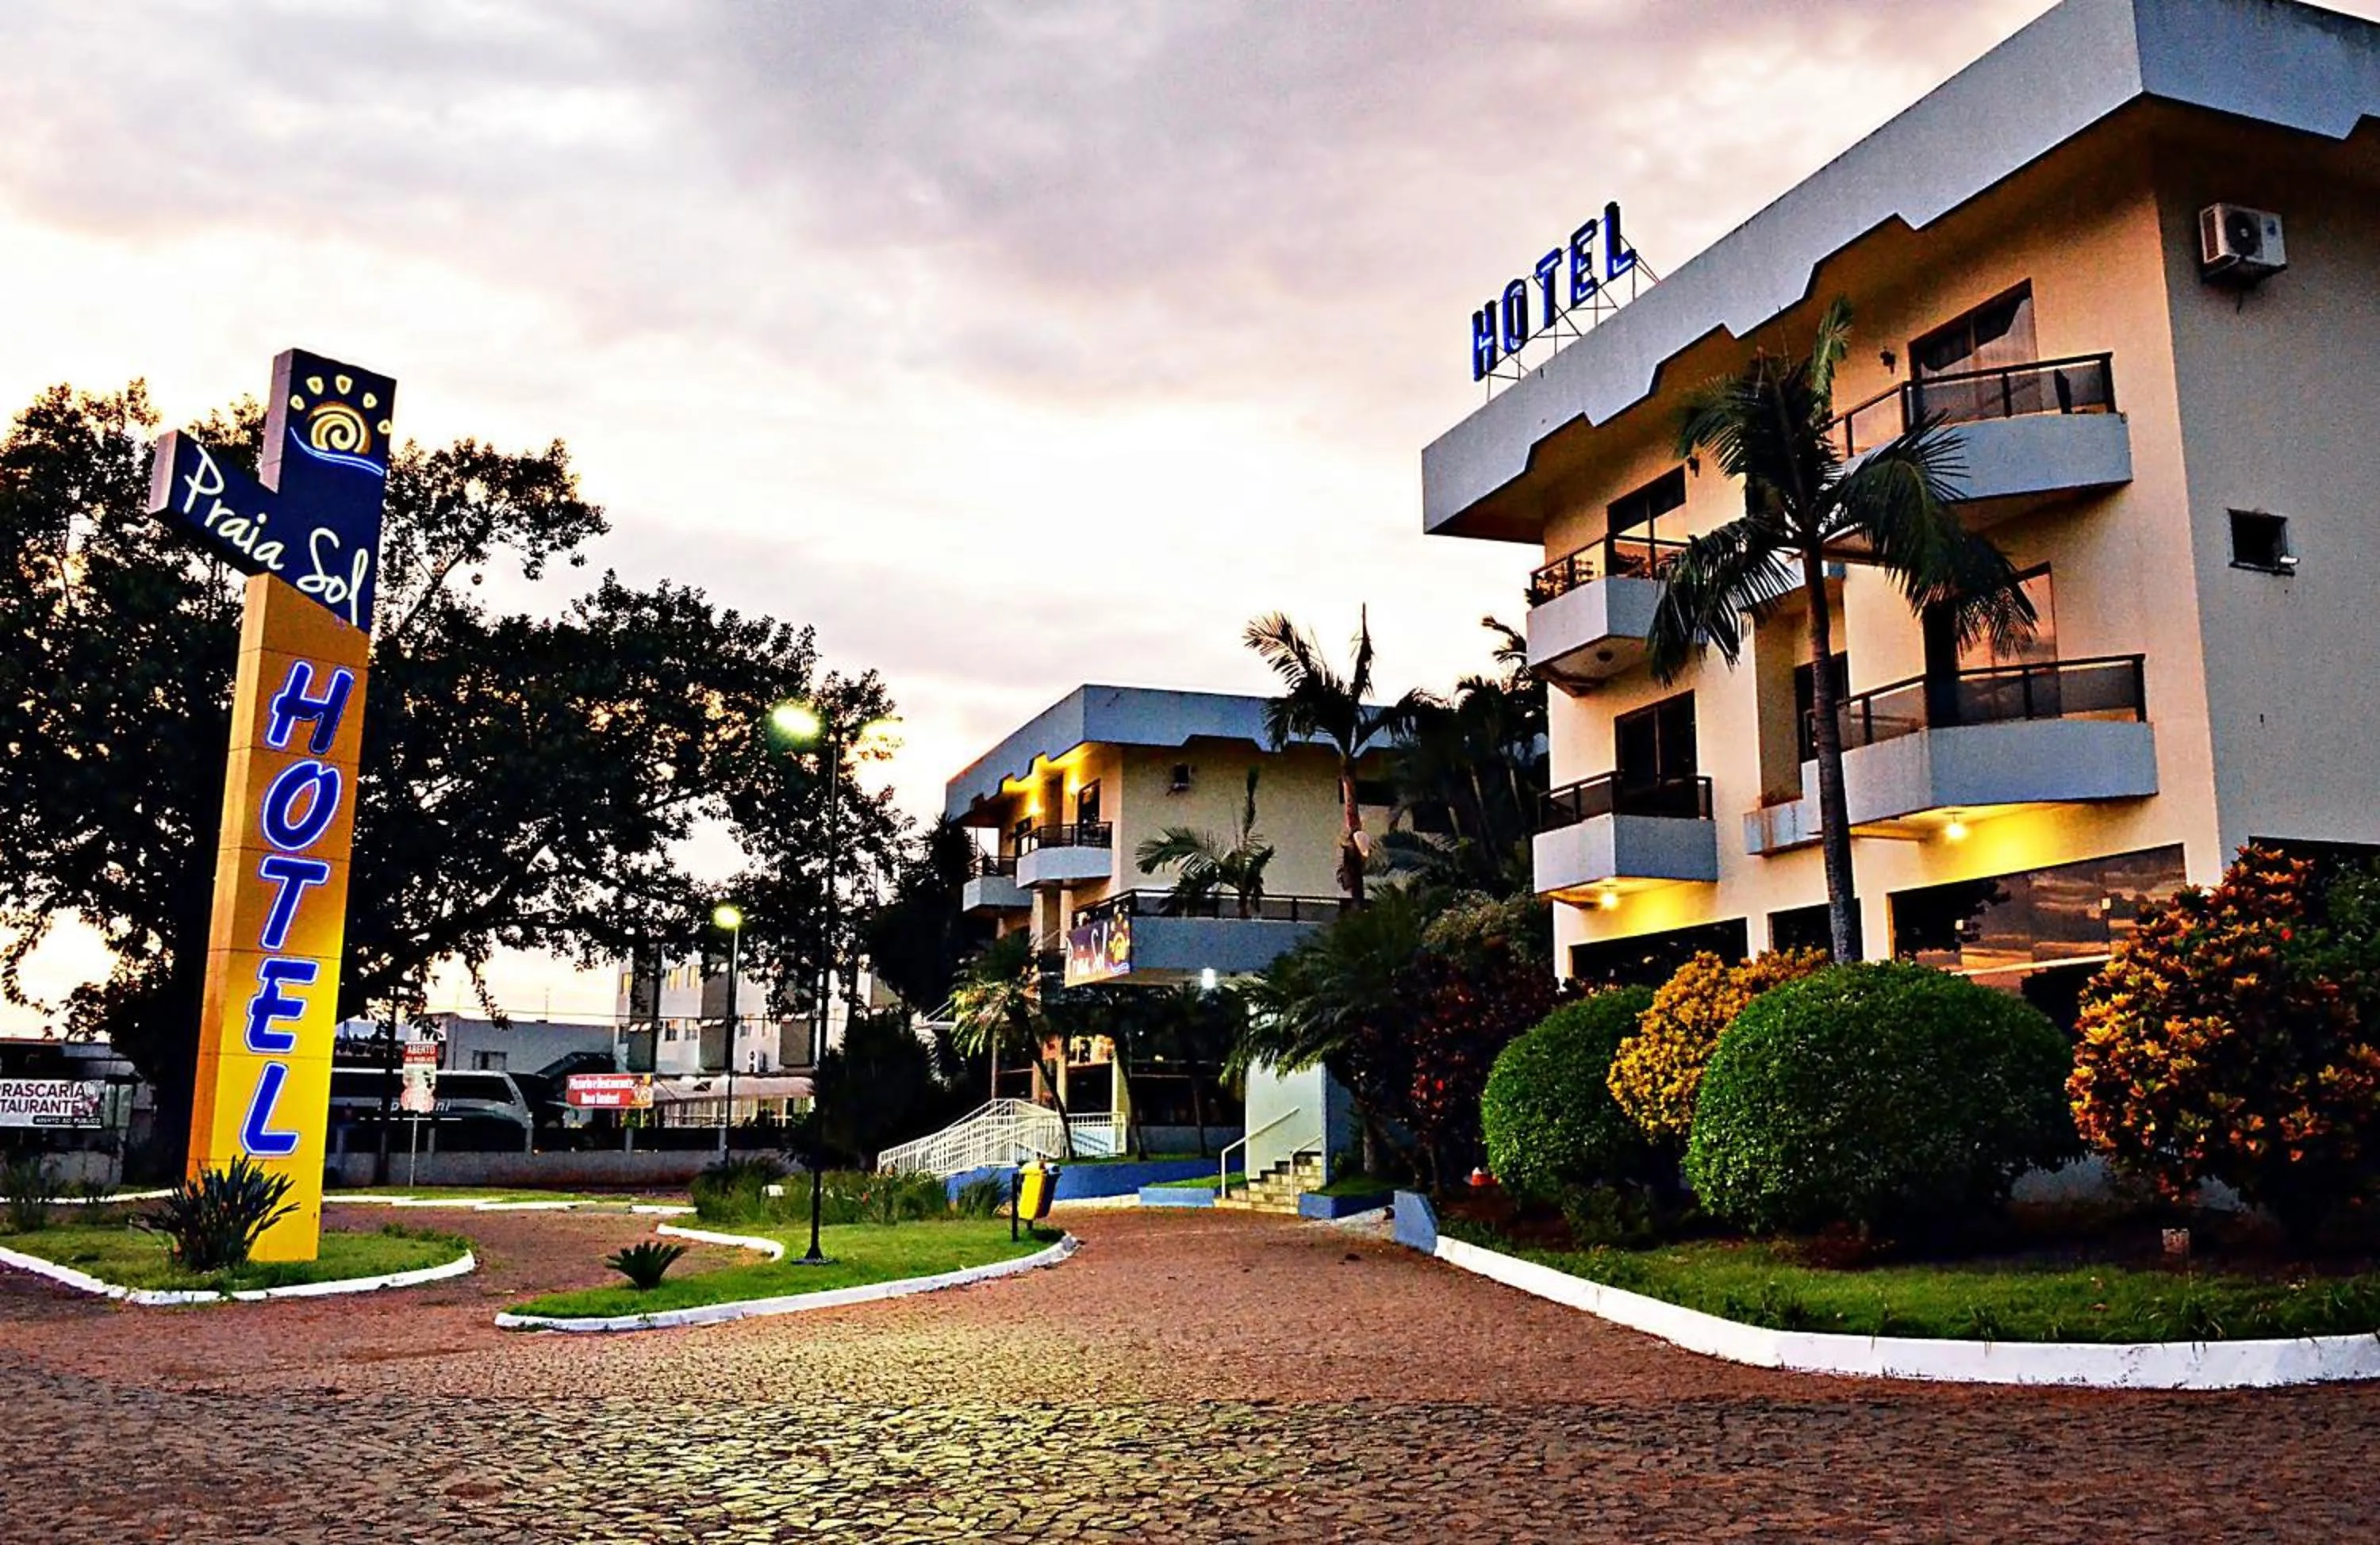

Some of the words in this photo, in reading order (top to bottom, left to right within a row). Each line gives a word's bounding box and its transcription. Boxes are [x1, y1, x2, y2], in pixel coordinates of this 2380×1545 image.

[1472, 201, 1637, 382] HOTEL
[183, 443, 285, 570] Praia
[297, 527, 369, 627] Sol
[240, 660, 355, 1156] HOTEL
[1091, 921, 1108, 975] Sol
[0, 1083, 85, 1098] RASCARIA
